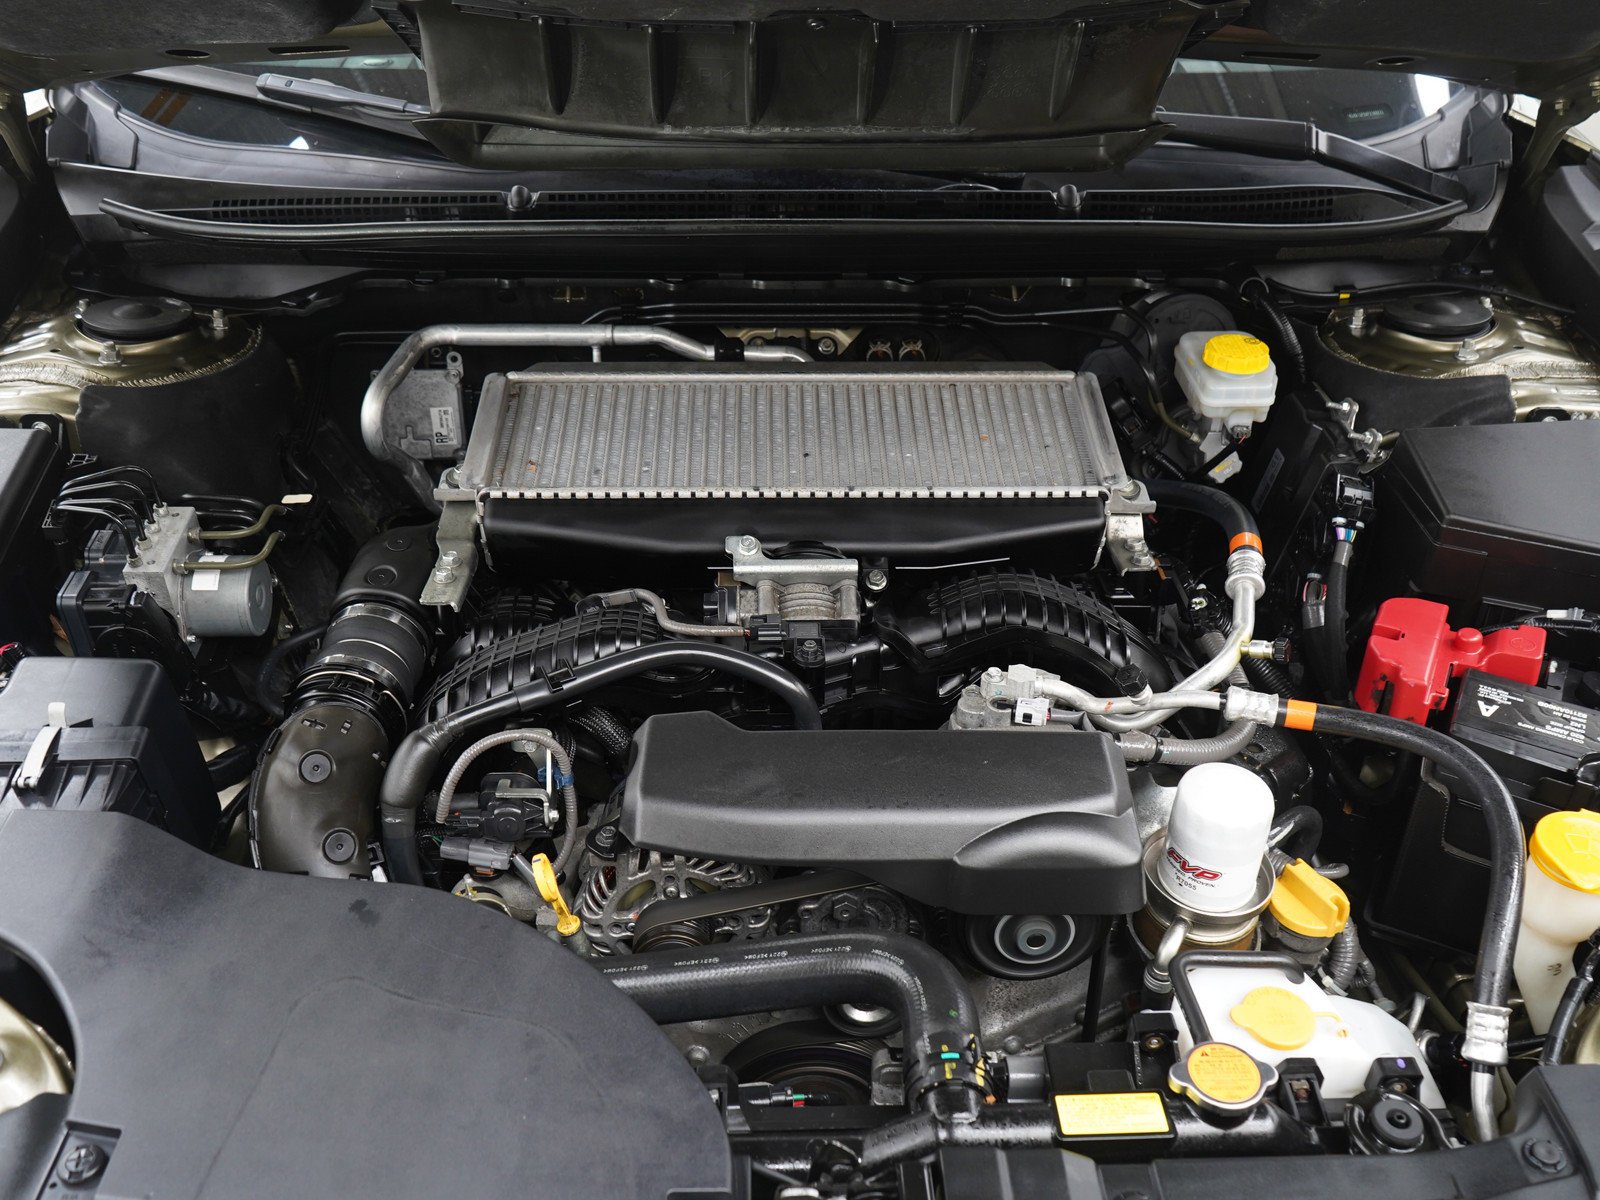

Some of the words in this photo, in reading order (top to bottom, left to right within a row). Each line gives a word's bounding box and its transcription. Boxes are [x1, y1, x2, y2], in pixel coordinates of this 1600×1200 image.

[435, 432, 448, 444] RP
[1517, 721, 1535, 730] AMPS
[1545, 725, 1570, 735] AMPS
[1563, 725, 1586, 734] GROUP
[1535, 727, 1567, 739] CRANKING
[1566, 736, 1585, 744] COLD
